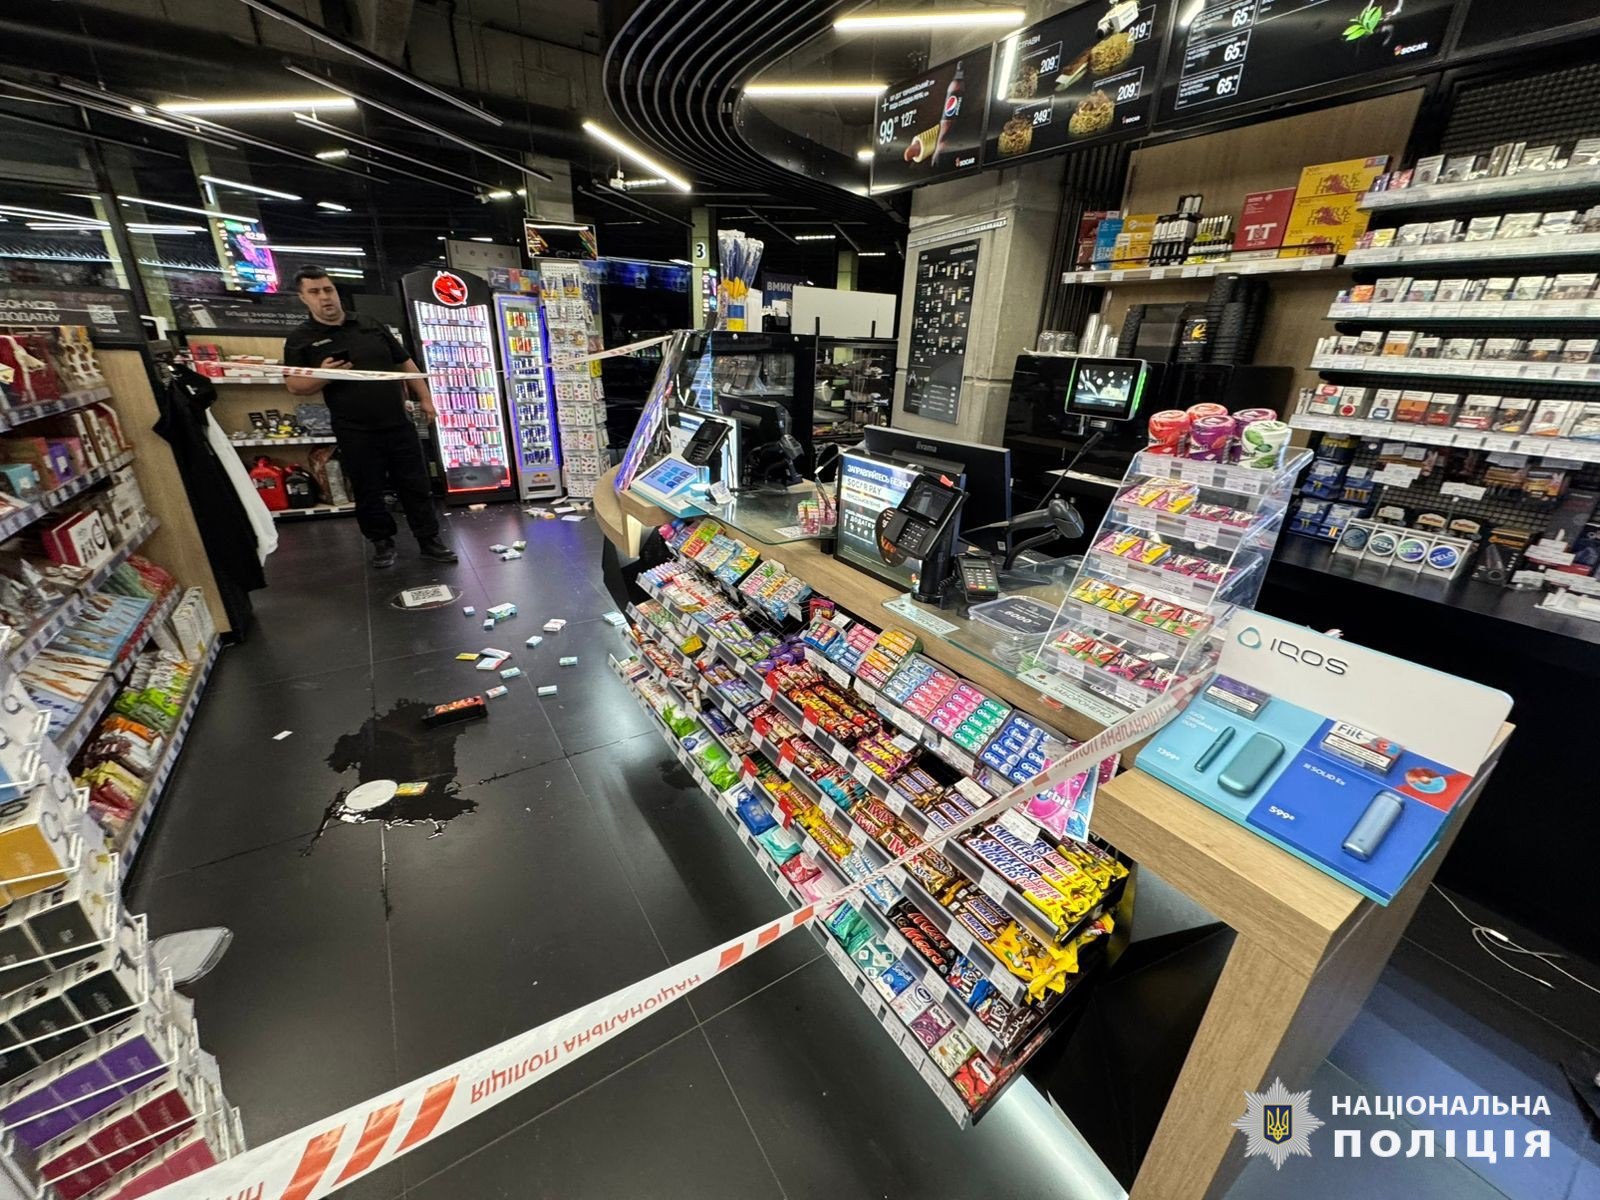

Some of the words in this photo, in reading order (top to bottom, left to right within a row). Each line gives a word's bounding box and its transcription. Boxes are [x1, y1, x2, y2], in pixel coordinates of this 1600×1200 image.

[1224, 42, 1240, 61] 65
[1117, 83, 1136, 101] 209
[1217, 76, 1232, 94] 65
[695, 242, 705, 260] 3
[1269, 638, 1350, 676] IQOS
[1337, 723, 1363, 740] Fiit
[1312, 767, 1336, 782] SOLID
[989, 824, 1040, 863] SNICKERS
[1036, 860, 1063, 883] SUPER
[1049, 853, 1077, 874] SUPER
[970, 838, 1021, 880] SNICKERS
[1021, 878, 1048, 902] SUPER
[1036, 879, 1062, 904] SUPER
[969, 899, 1000, 927] SNICKERS
[963, 912, 995, 941] SNICKERS
[564, 974, 701, 1054] НАЦІОНАЛЬНА
[470, 1044, 559, 1105] ПОЛІЦІЯ
